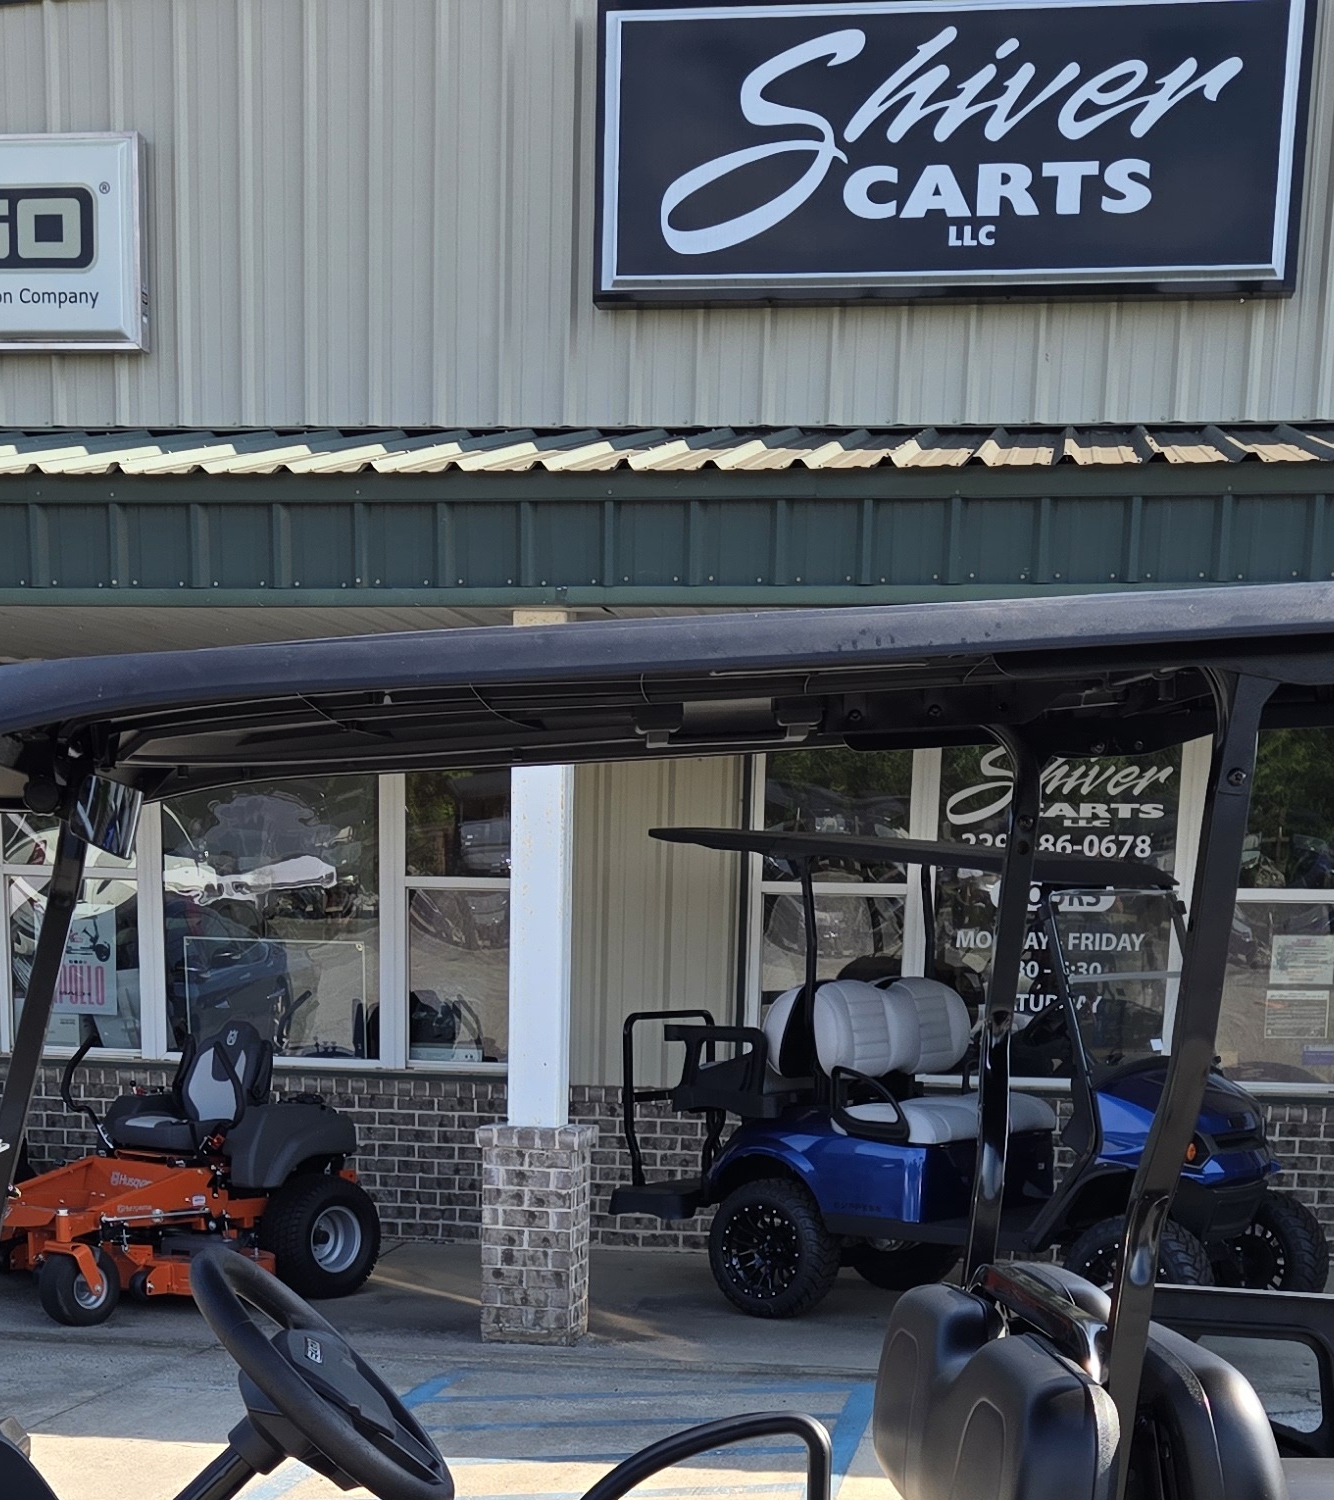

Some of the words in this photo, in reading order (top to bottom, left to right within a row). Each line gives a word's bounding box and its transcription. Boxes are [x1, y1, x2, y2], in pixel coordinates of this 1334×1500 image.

[661, 26, 1244, 255] Shiver
[843, 158, 1153, 219] CARTS
[947, 225, 996, 247] LLC
[19, 287, 99, 308] Company
[1063, 819, 1110, 827] LLC
[1068, 933, 1145, 951] FRIDAY
